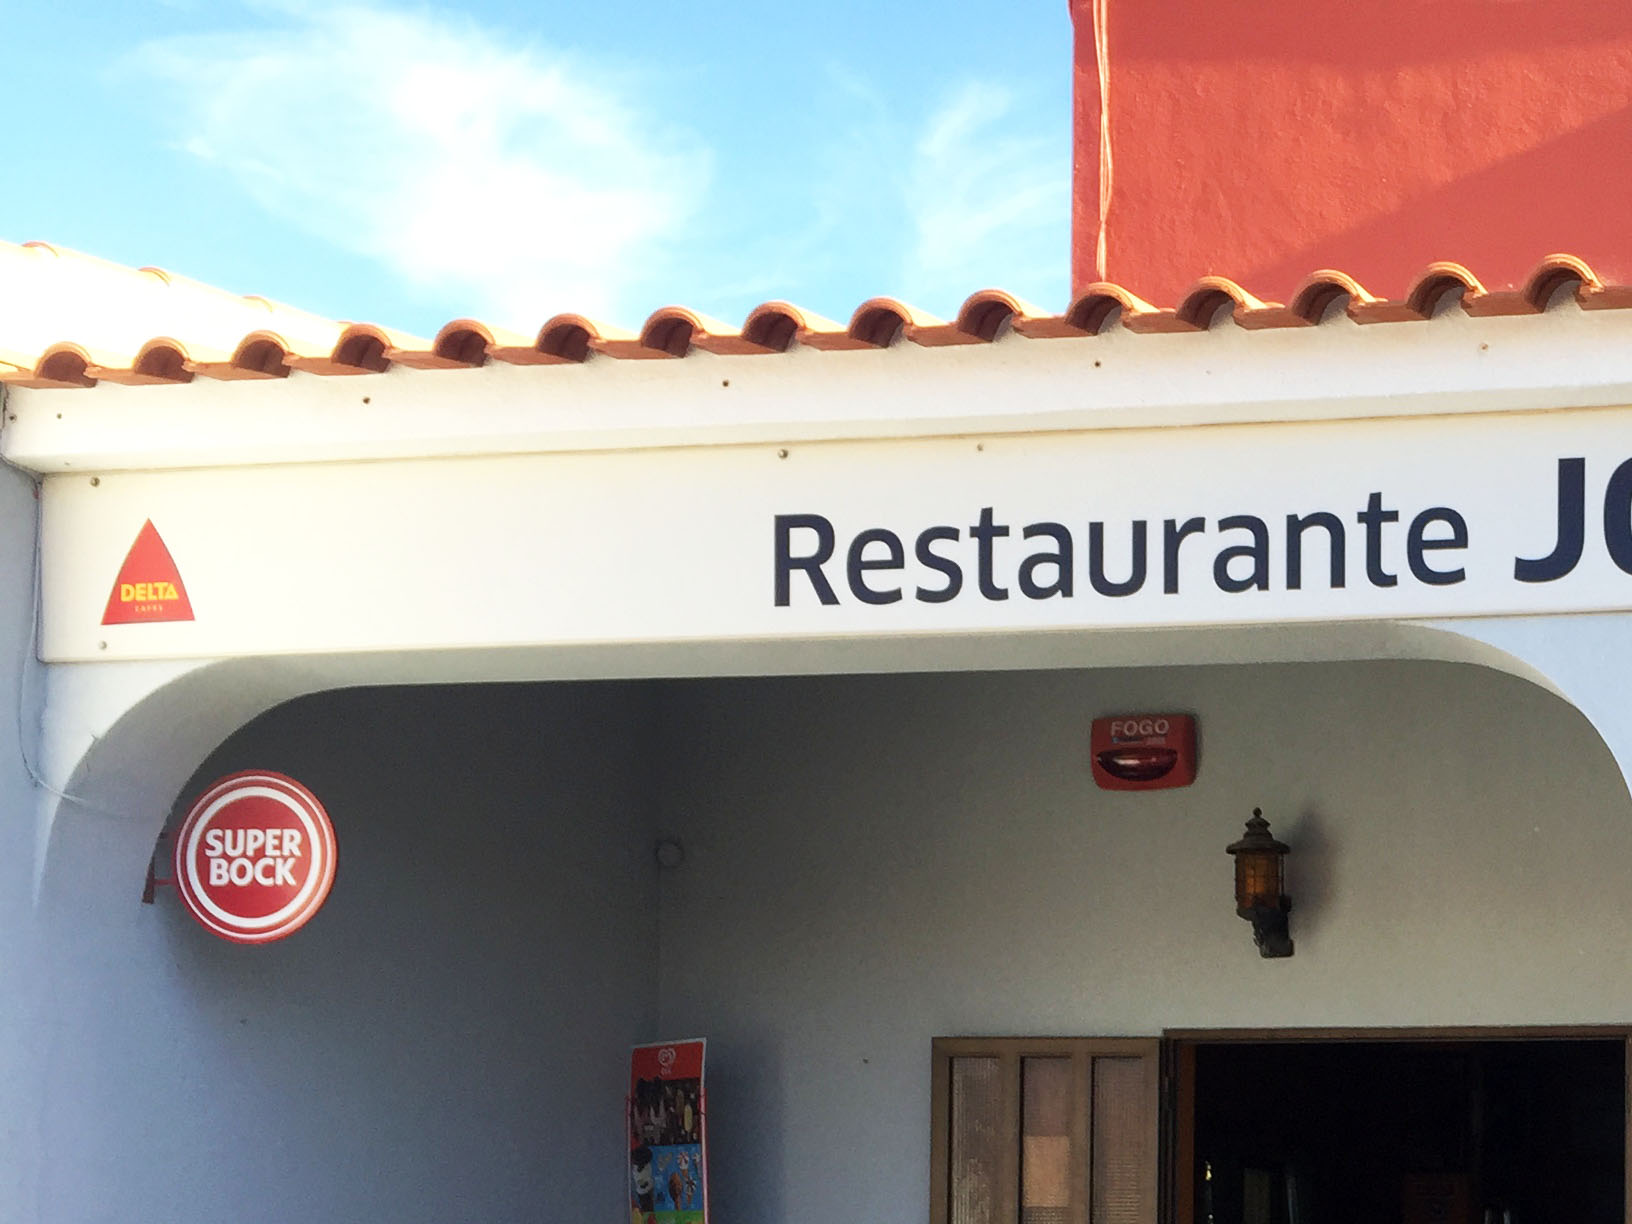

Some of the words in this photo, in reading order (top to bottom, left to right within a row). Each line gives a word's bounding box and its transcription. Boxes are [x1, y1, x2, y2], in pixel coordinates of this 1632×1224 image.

[773, 492, 1470, 608] Restaurante
[120, 581, 179, 602] DELTA
[1110, 719, 1170, 736] FOGO
[205, 828, 302, 857] SUPER
[209, 857, 297, 887] BOCK
